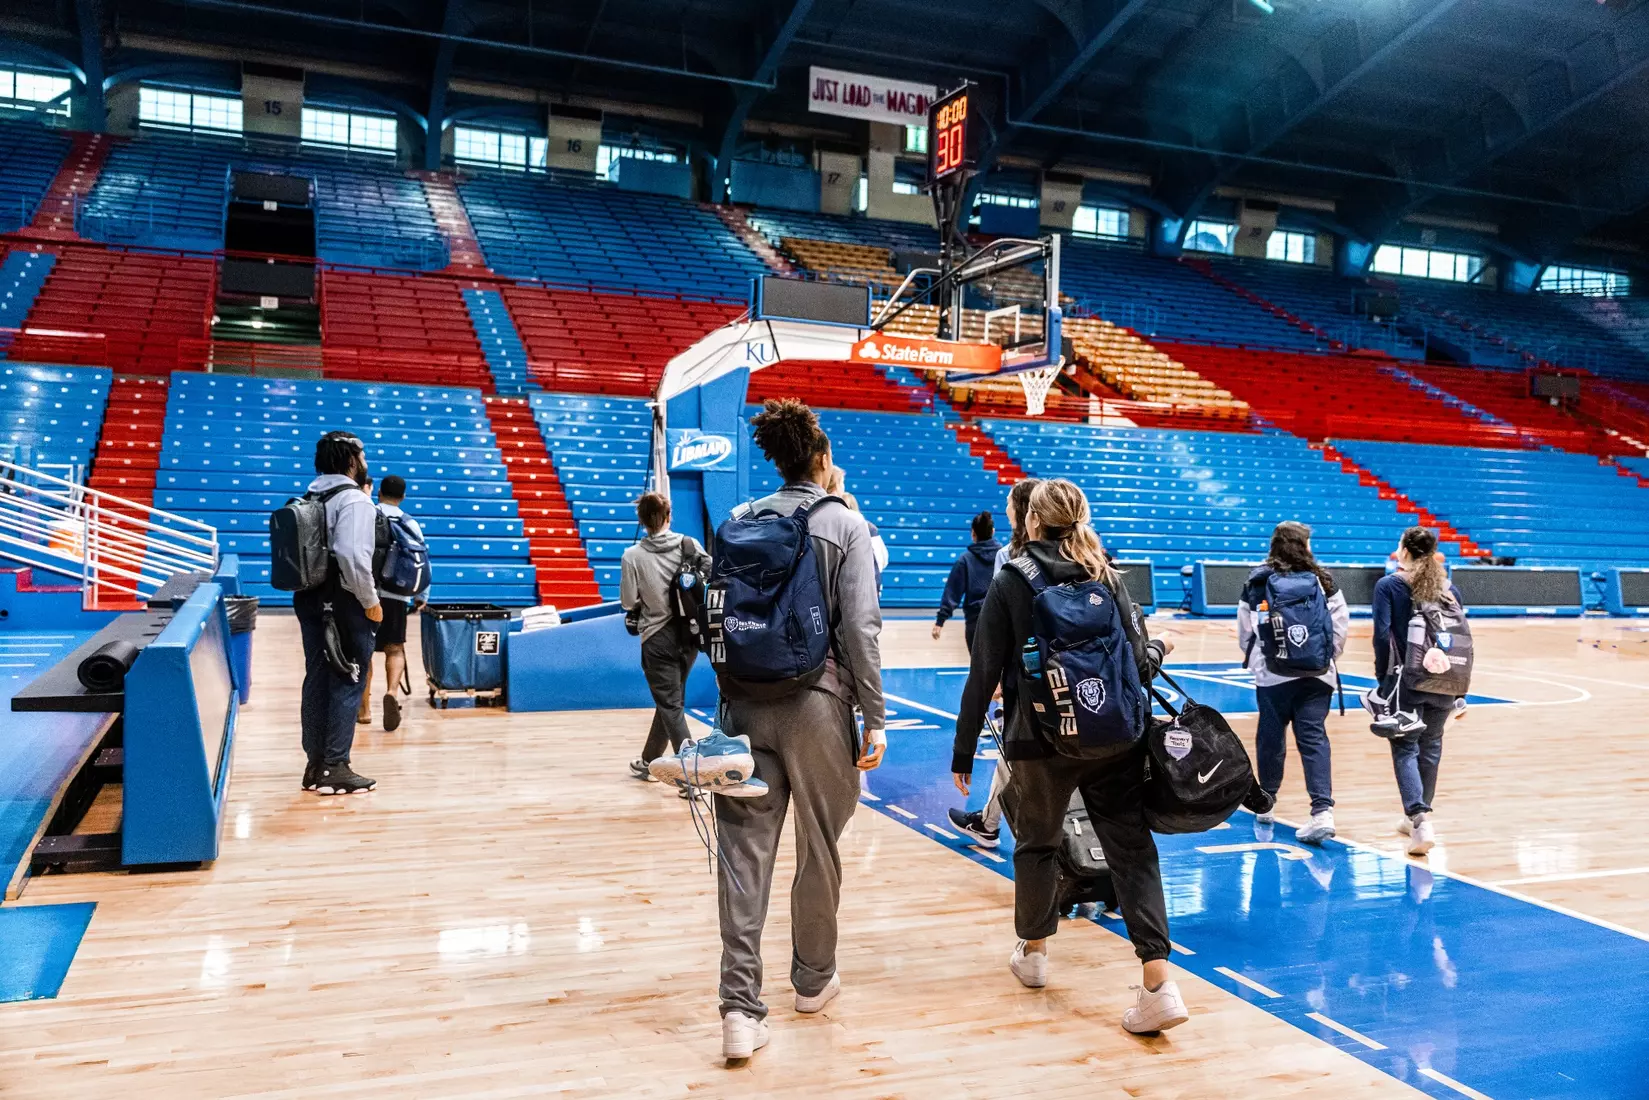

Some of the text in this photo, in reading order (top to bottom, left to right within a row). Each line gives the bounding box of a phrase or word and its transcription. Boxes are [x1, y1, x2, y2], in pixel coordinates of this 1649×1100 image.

[264, 100, 282, 115] 15
[812, 77, 933, 117] JUST LOAD THE WAGON
[937, 96, 967, 129] 10:00
[567, 138, 582, 153] 16
[937, 124, 962, 172] 30
[828, 172, 840, 184] 17
[746, 342, 776, 365] KU
[706, 588, 727, 664] ELITE
[1270, 616, 1289, 660] ELITE
[1046, 667, 1079, 737] ELITE
